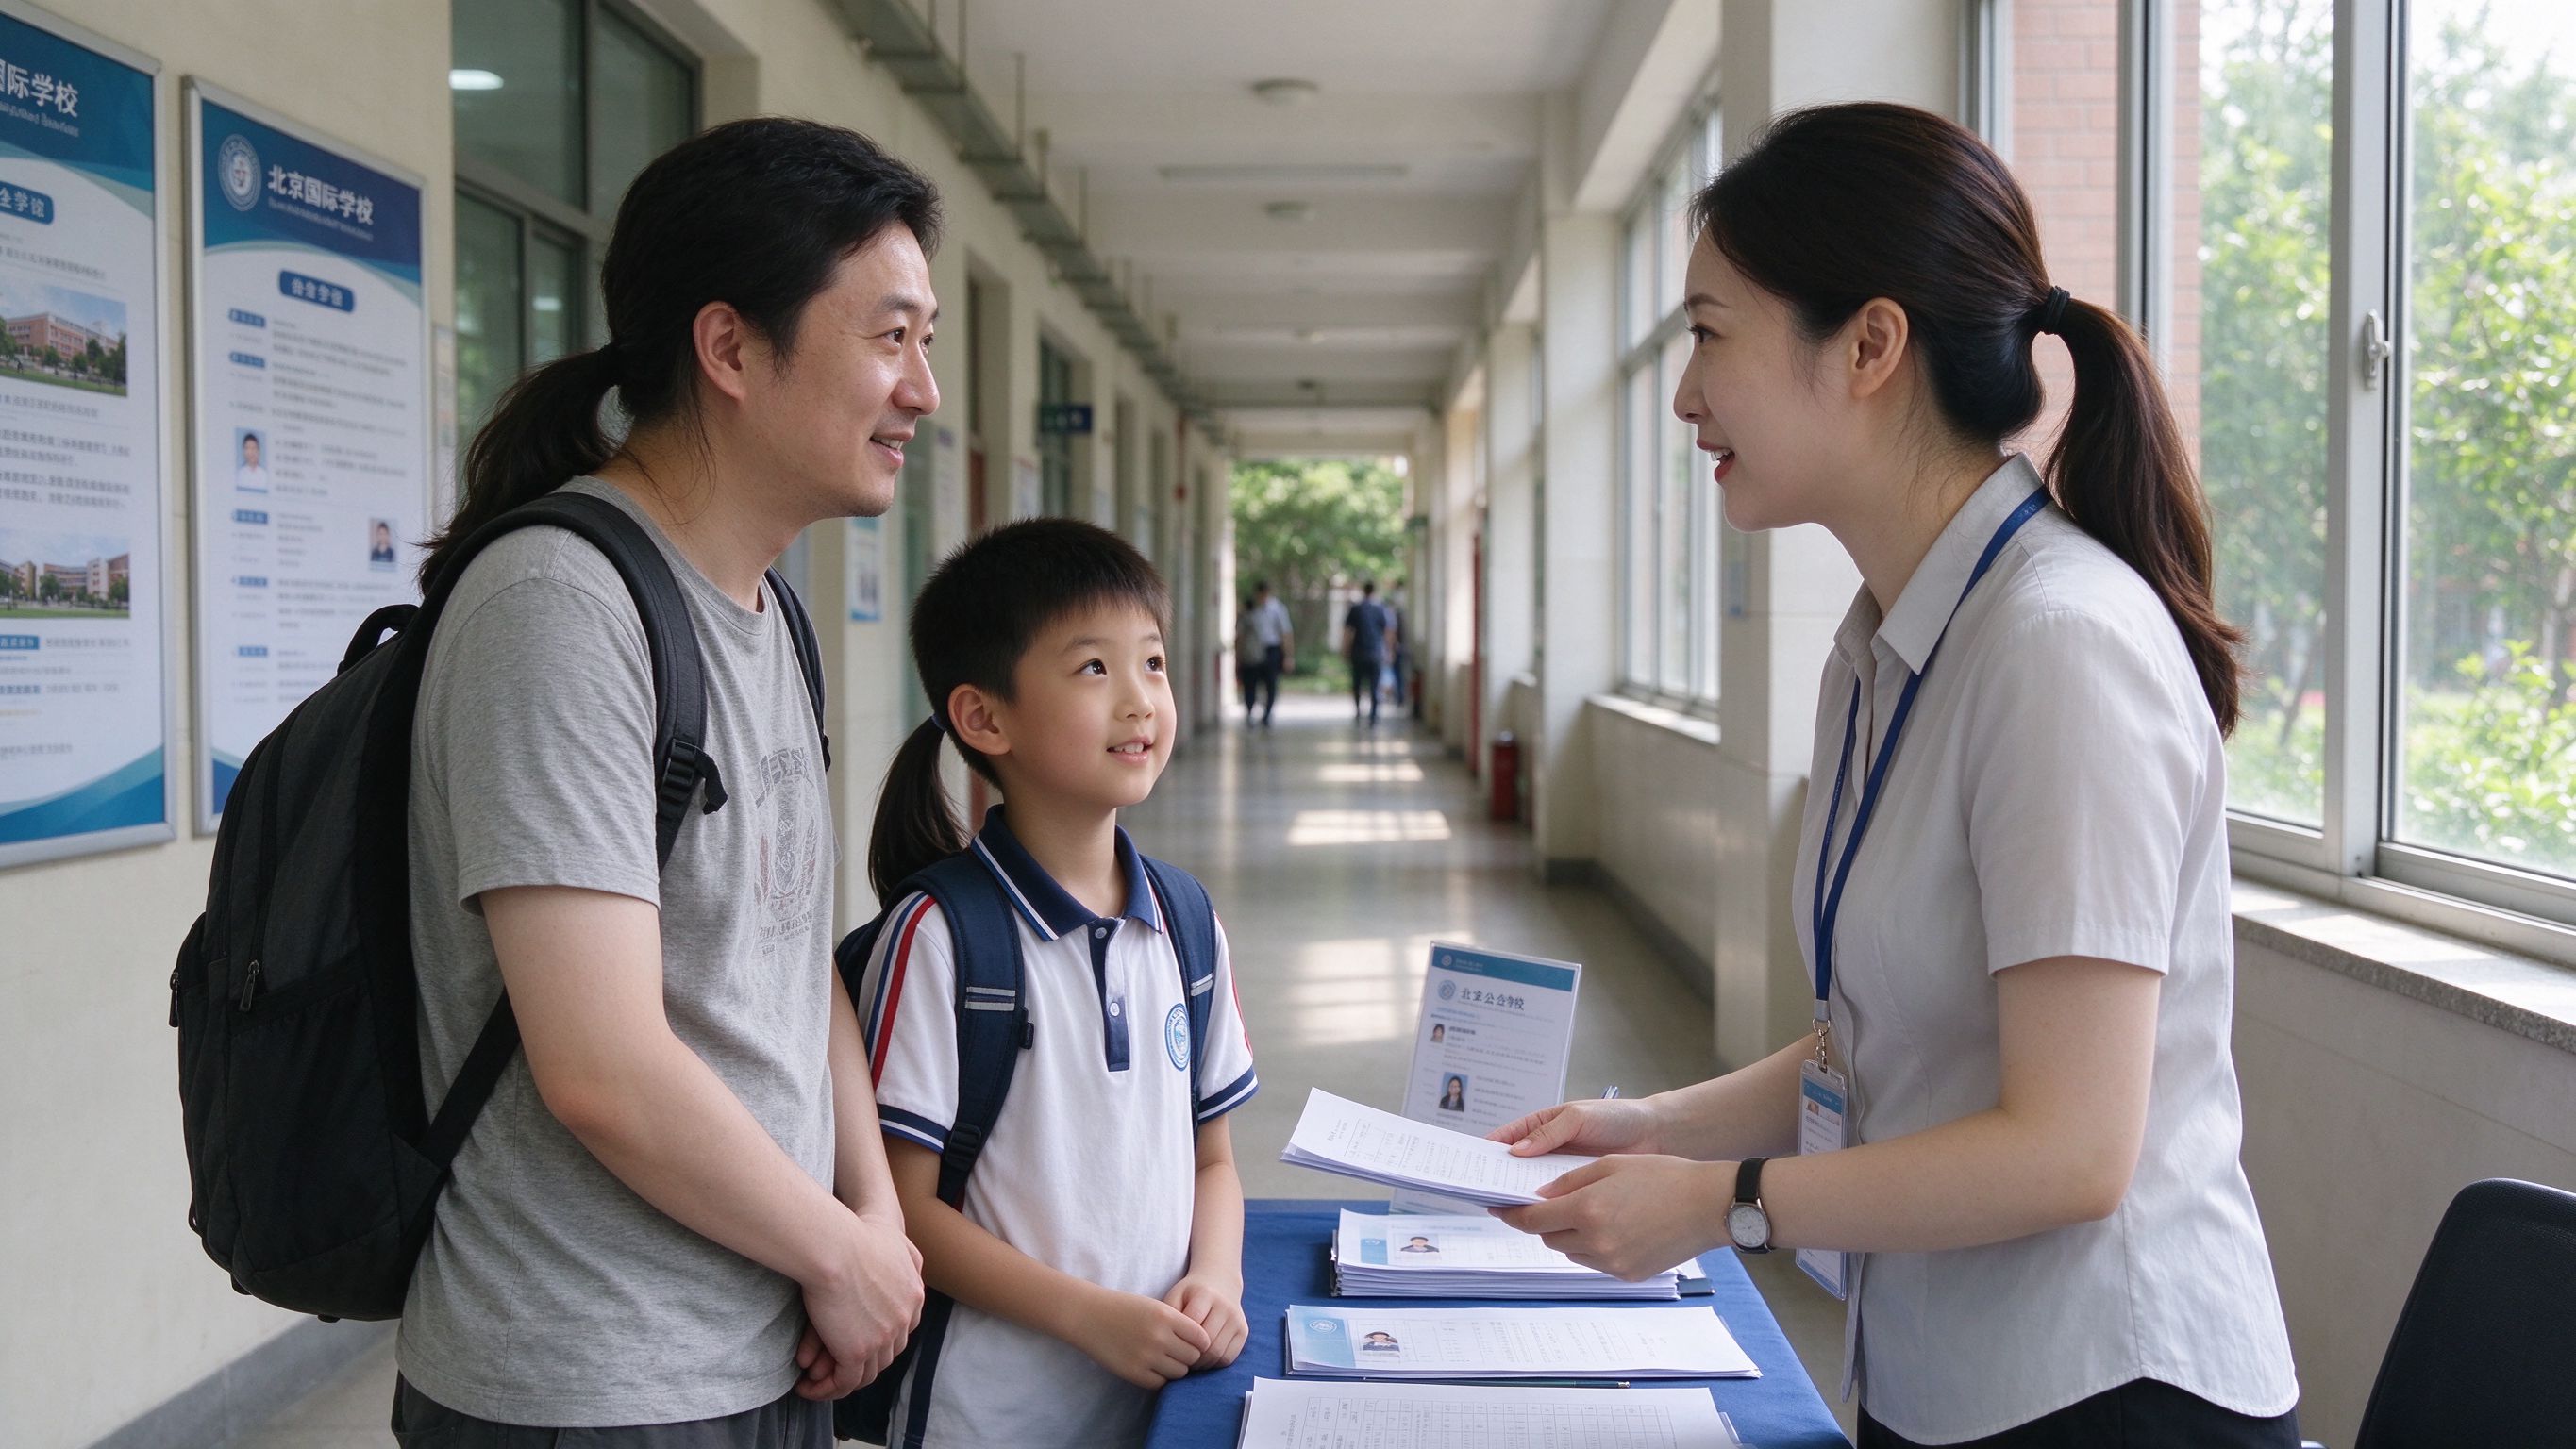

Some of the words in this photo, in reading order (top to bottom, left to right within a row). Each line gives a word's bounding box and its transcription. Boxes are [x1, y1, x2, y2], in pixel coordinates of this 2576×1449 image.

[0, 58, 78, 118] 际学校
[268, 164, 374, 225] 北京国际学校
